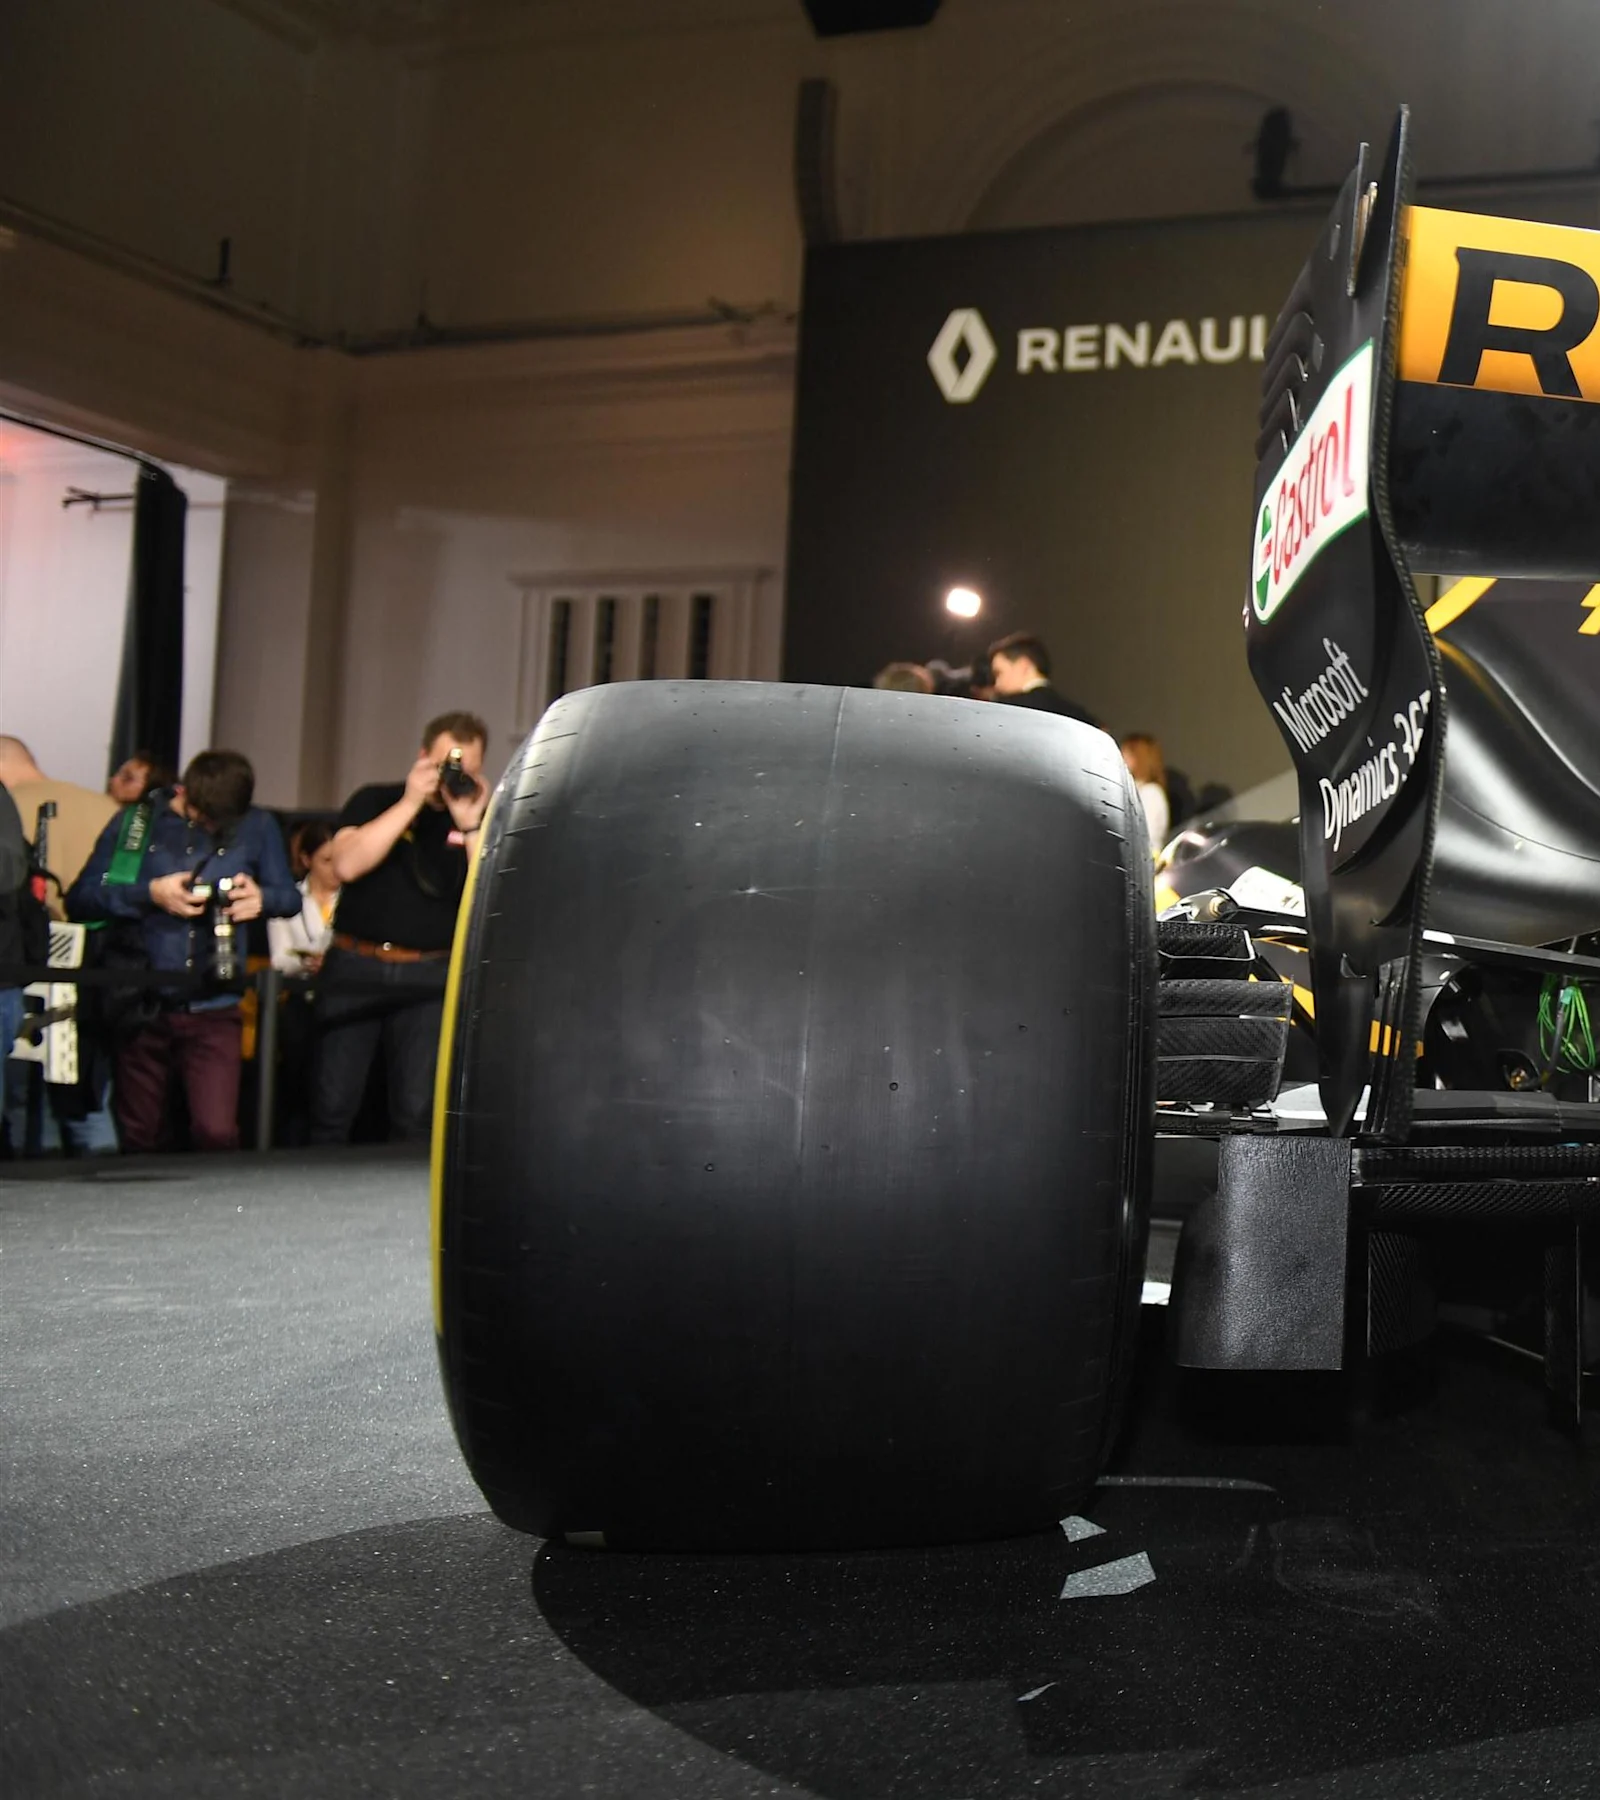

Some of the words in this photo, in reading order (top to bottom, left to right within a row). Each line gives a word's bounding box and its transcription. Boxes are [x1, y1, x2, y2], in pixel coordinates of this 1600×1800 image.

[1016, 313, 1266, 374] RENAUL
[1274, 382, 1355, 585] Castrol
[1273, 637, 1369, 753] Microsoft
[1318, 735, 1400, 852] Dynamics
